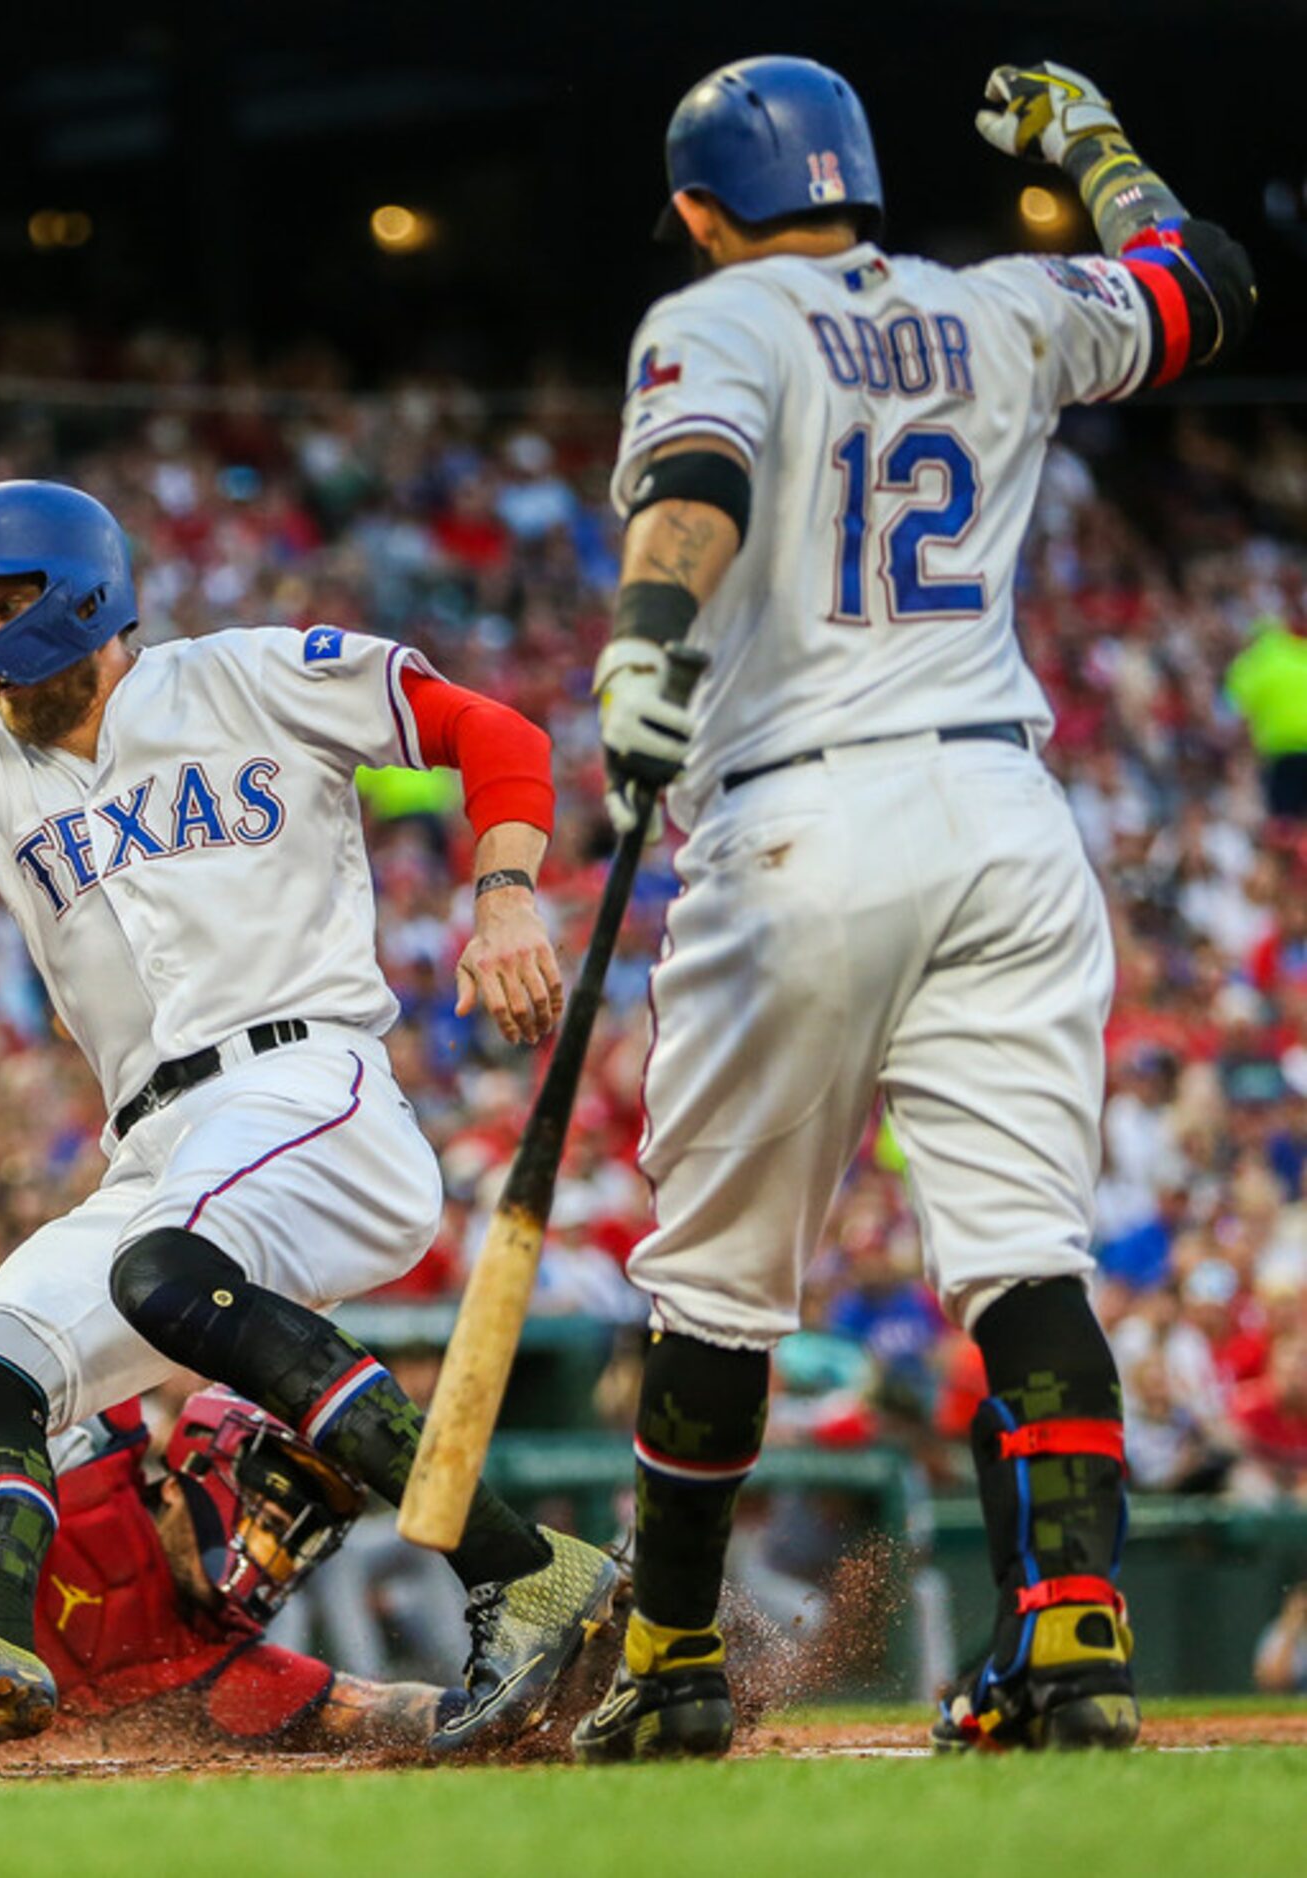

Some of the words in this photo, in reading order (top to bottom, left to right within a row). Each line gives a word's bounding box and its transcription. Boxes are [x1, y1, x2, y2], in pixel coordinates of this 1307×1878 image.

[809, 310, 975, 398] ODOR
[827, 423, 987, 626] 12
[13, 757, 285, 920] TEXAS
